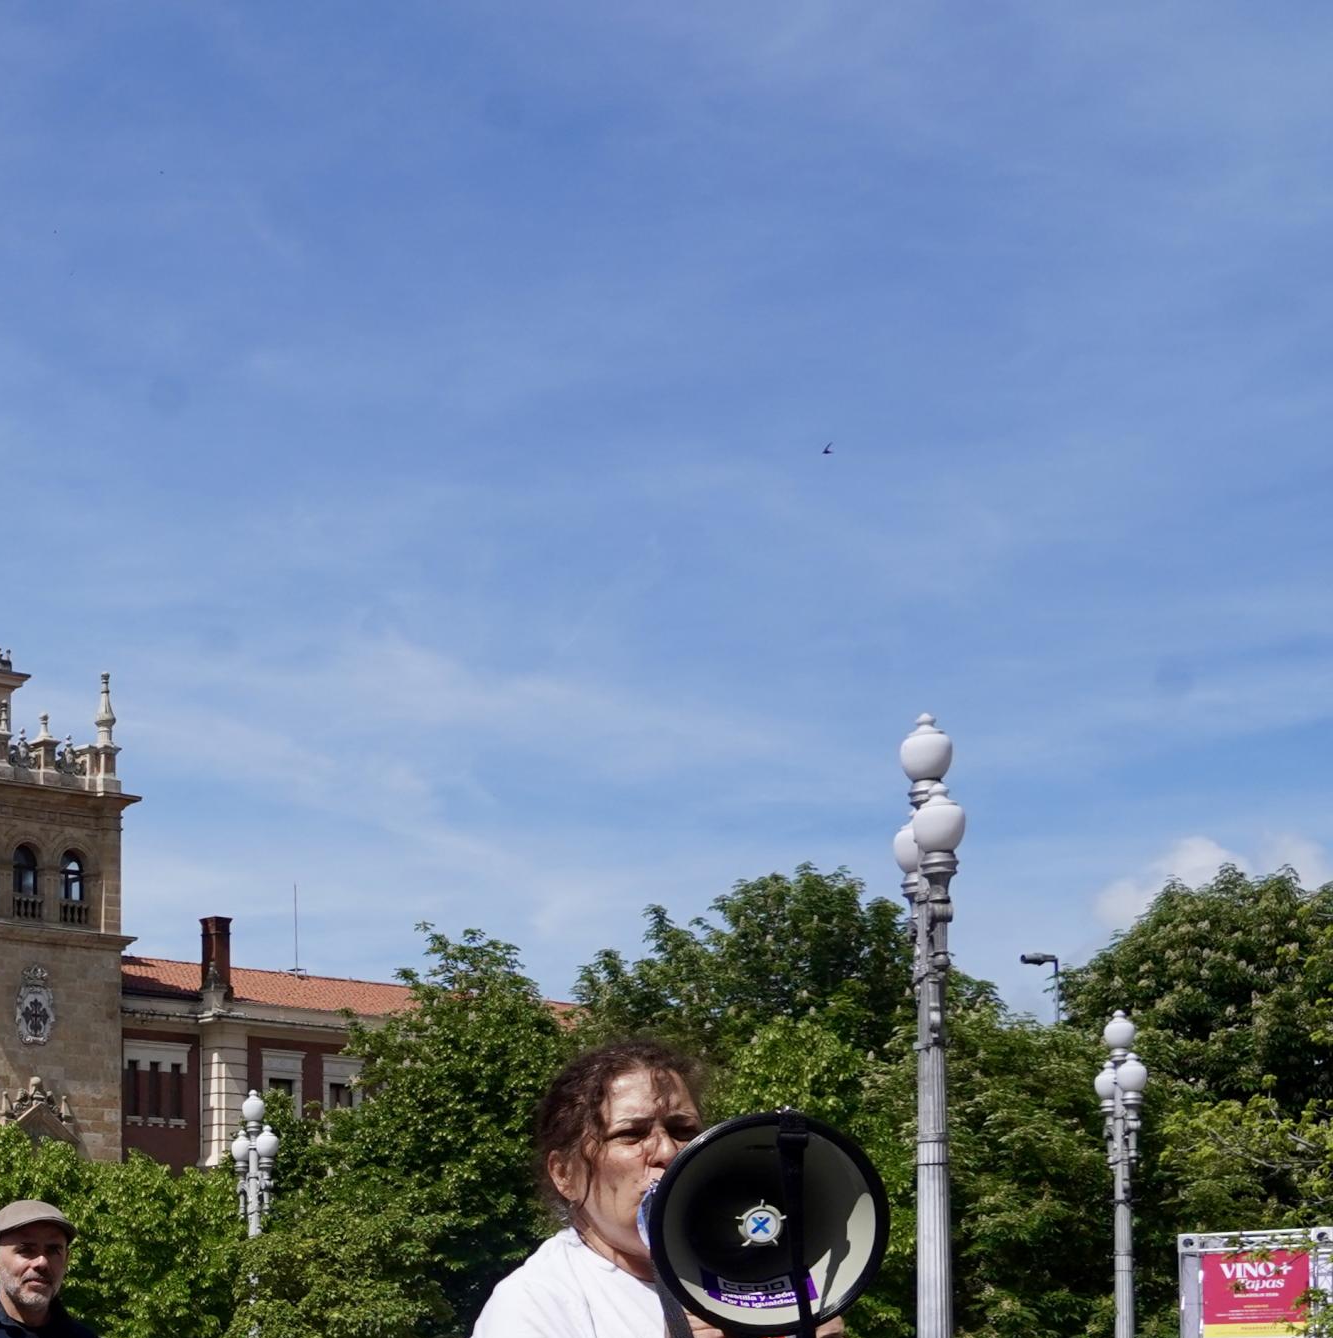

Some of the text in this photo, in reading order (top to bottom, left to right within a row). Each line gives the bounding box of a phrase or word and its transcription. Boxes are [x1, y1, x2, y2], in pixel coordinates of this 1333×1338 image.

[1220, 1261, 1277, 1279] VINO
[723, 1280, 786, 1292] CCOO
[751, 1297, 798, 1309] igualdad
